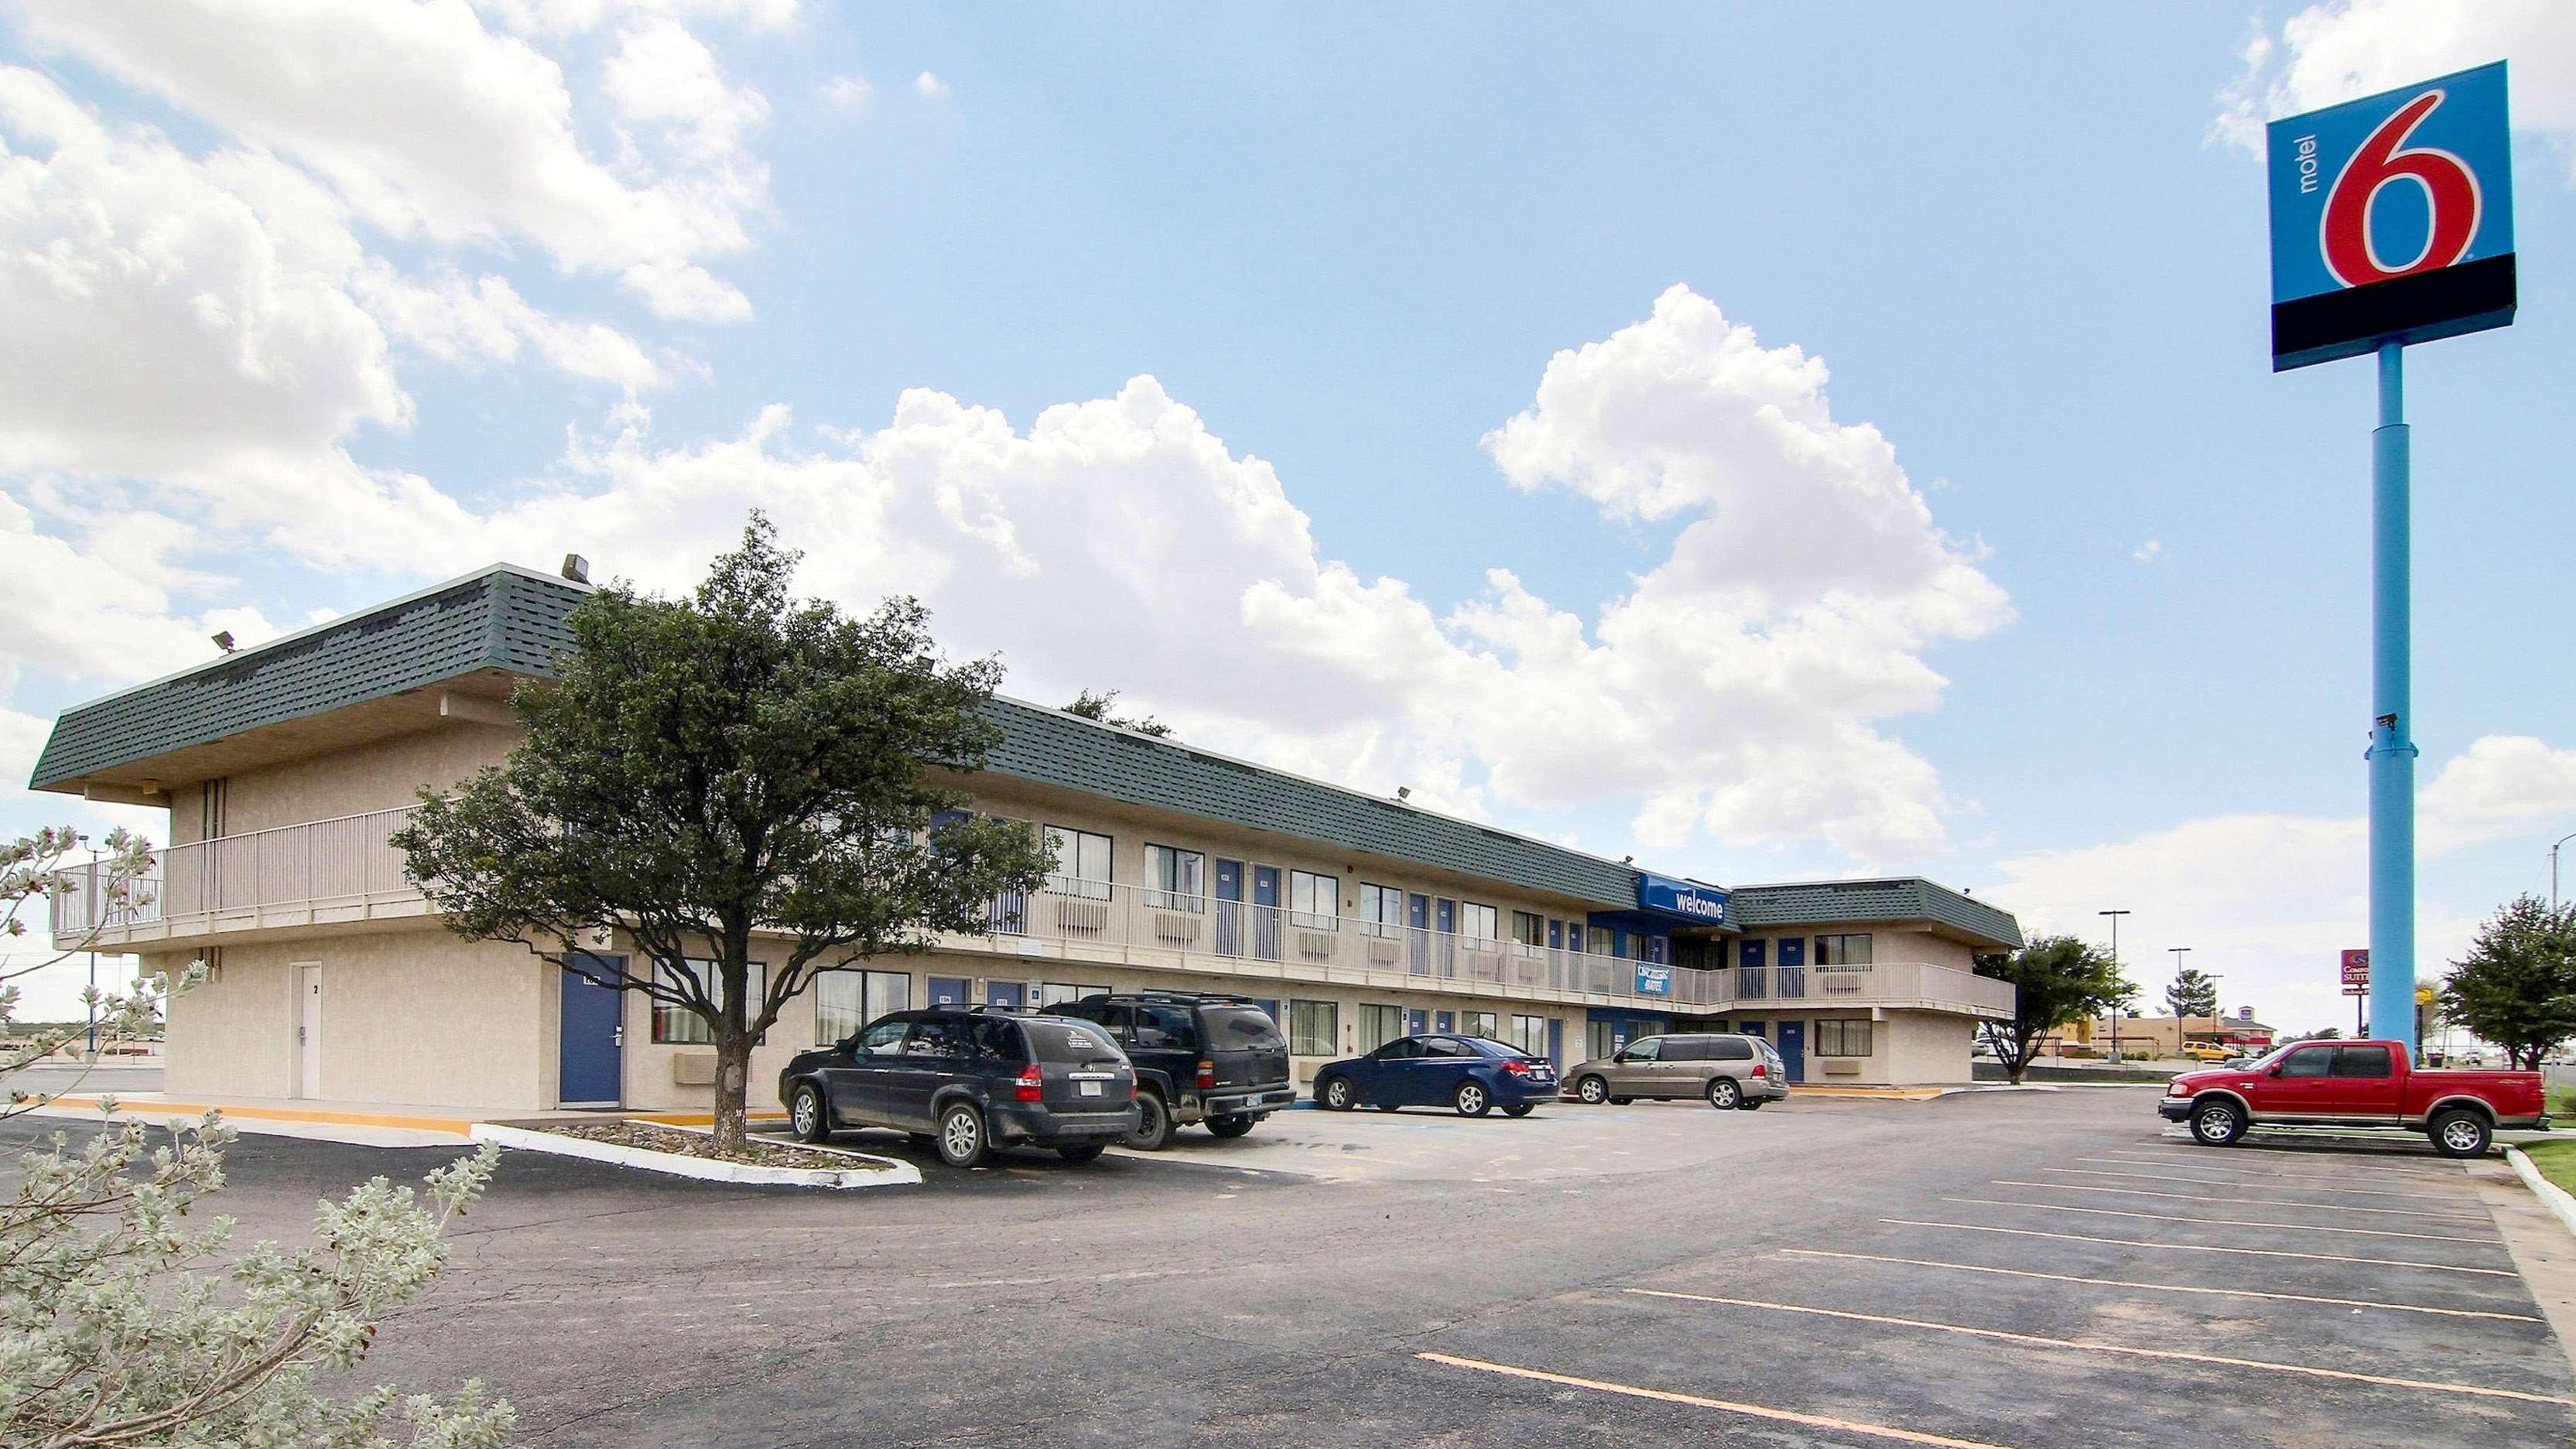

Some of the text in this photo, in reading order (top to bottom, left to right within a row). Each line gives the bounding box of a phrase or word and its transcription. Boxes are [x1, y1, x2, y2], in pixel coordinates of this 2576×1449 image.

[2293, 134, 2318, 194] motel
[2319, 88, 2482, 289] 6
[1676, 889, 1723, 919] welcome
[313, 985, 318, 994] 2
